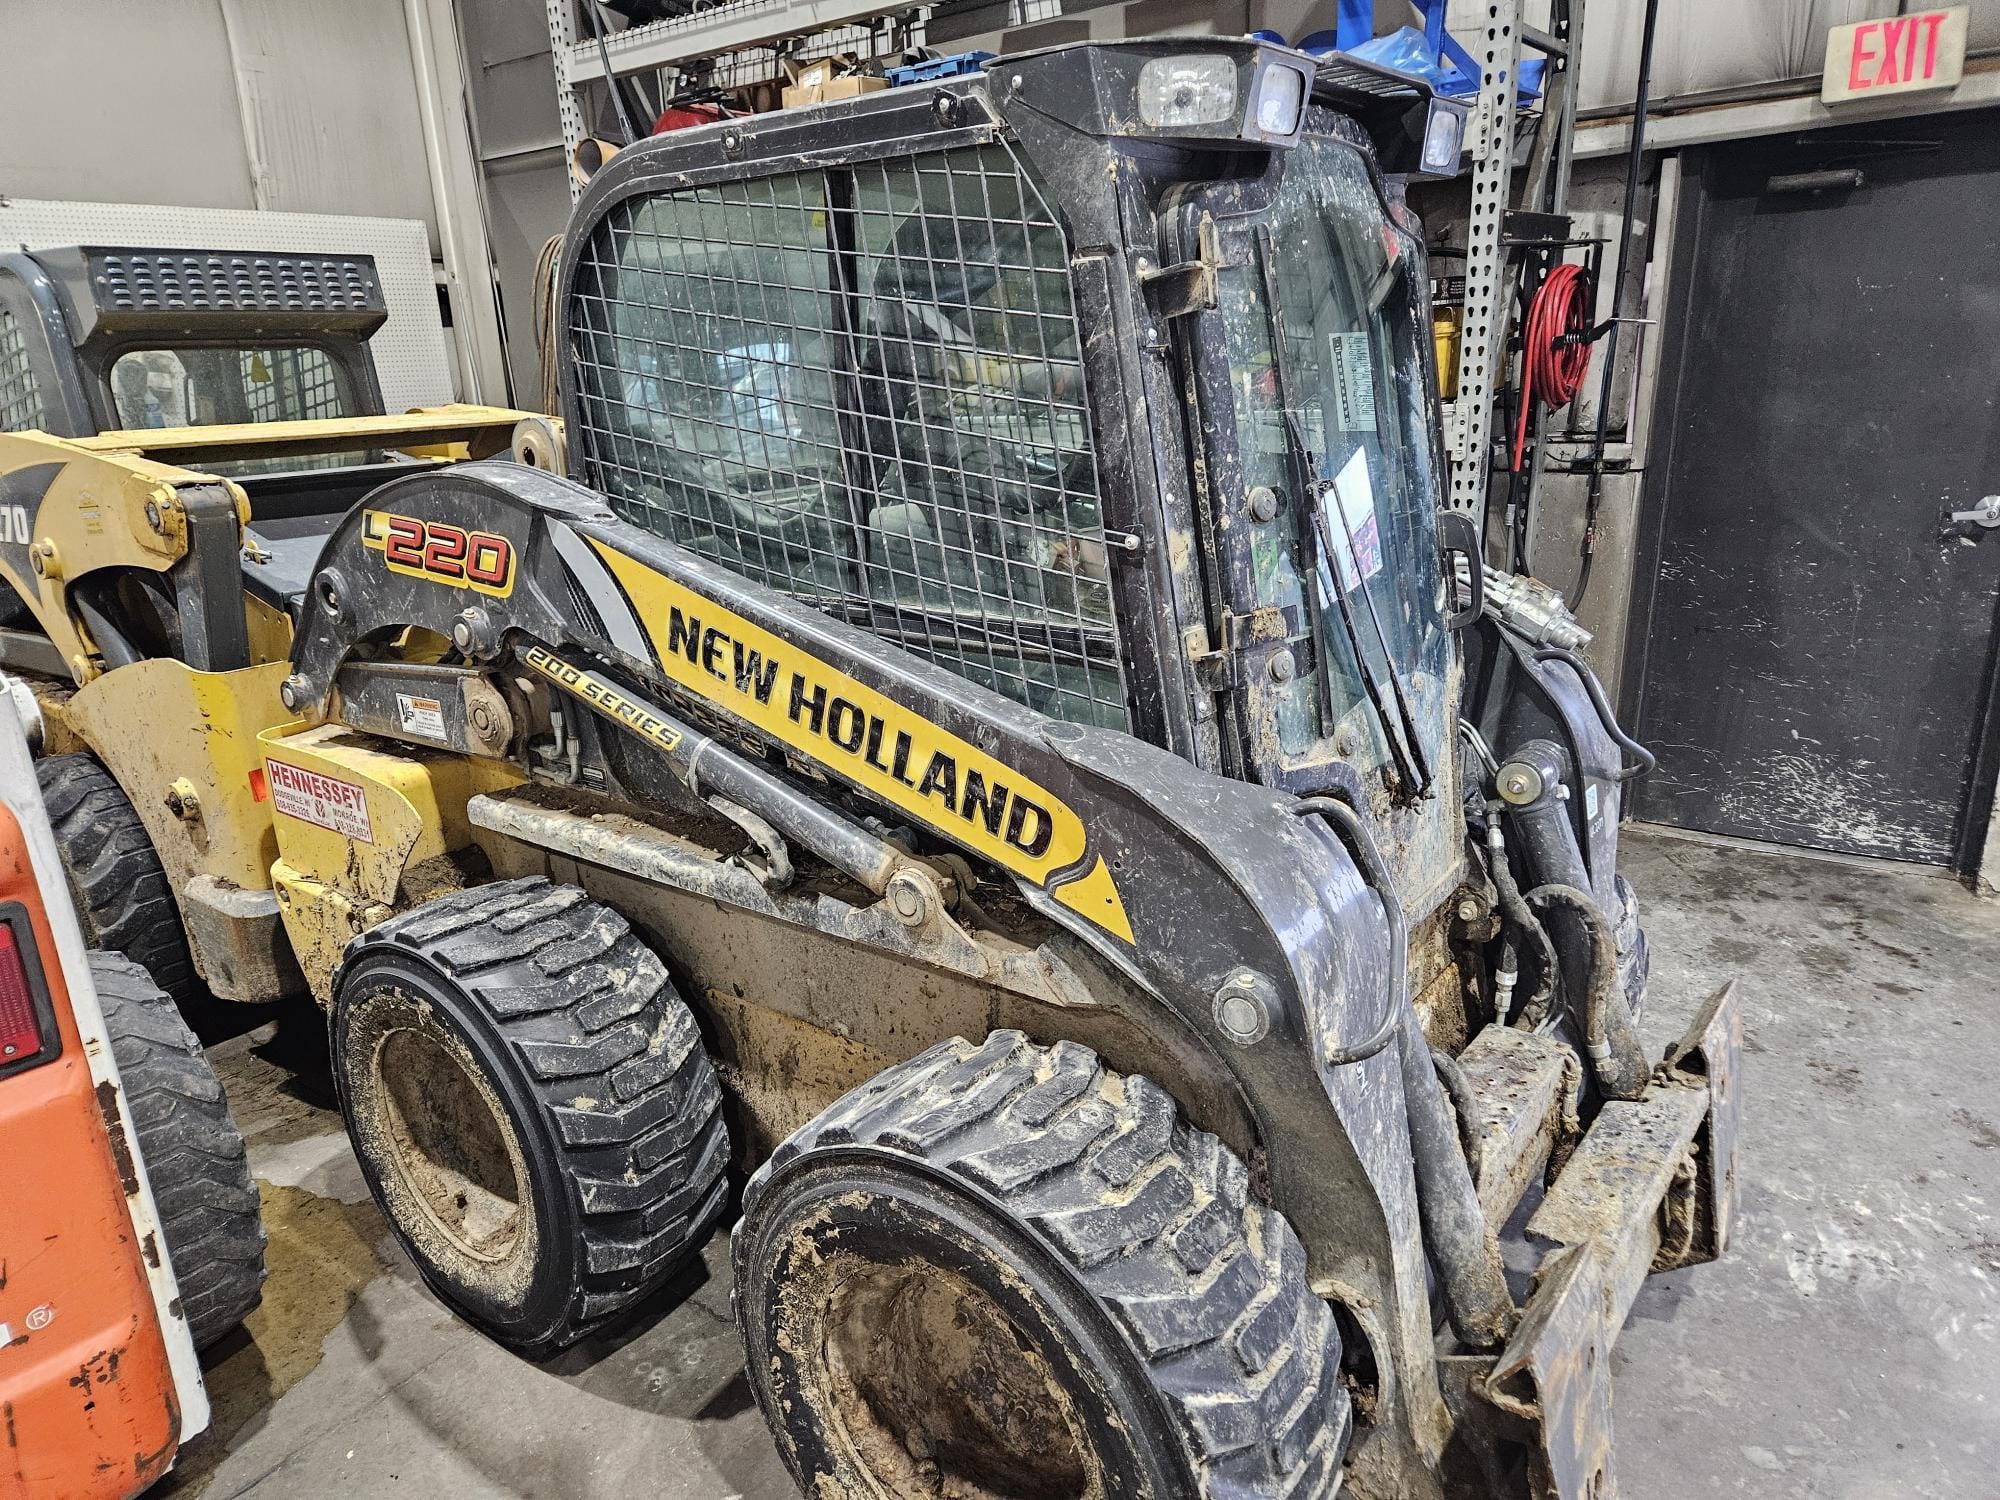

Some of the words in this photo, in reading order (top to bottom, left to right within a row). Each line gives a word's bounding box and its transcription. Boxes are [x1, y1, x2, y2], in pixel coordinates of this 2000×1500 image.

[1848, 12, 1948, 90] EXIT
[364, 513, 511, 589] L220
[528, 648, 581, 686] 200
[581, 682, 680, 746] SERIES
[667, 605, 780, 706] NEW
[787, 671, 1054, 860] HOLLAND
[270, 763, 362, 812] HENNESSEY
